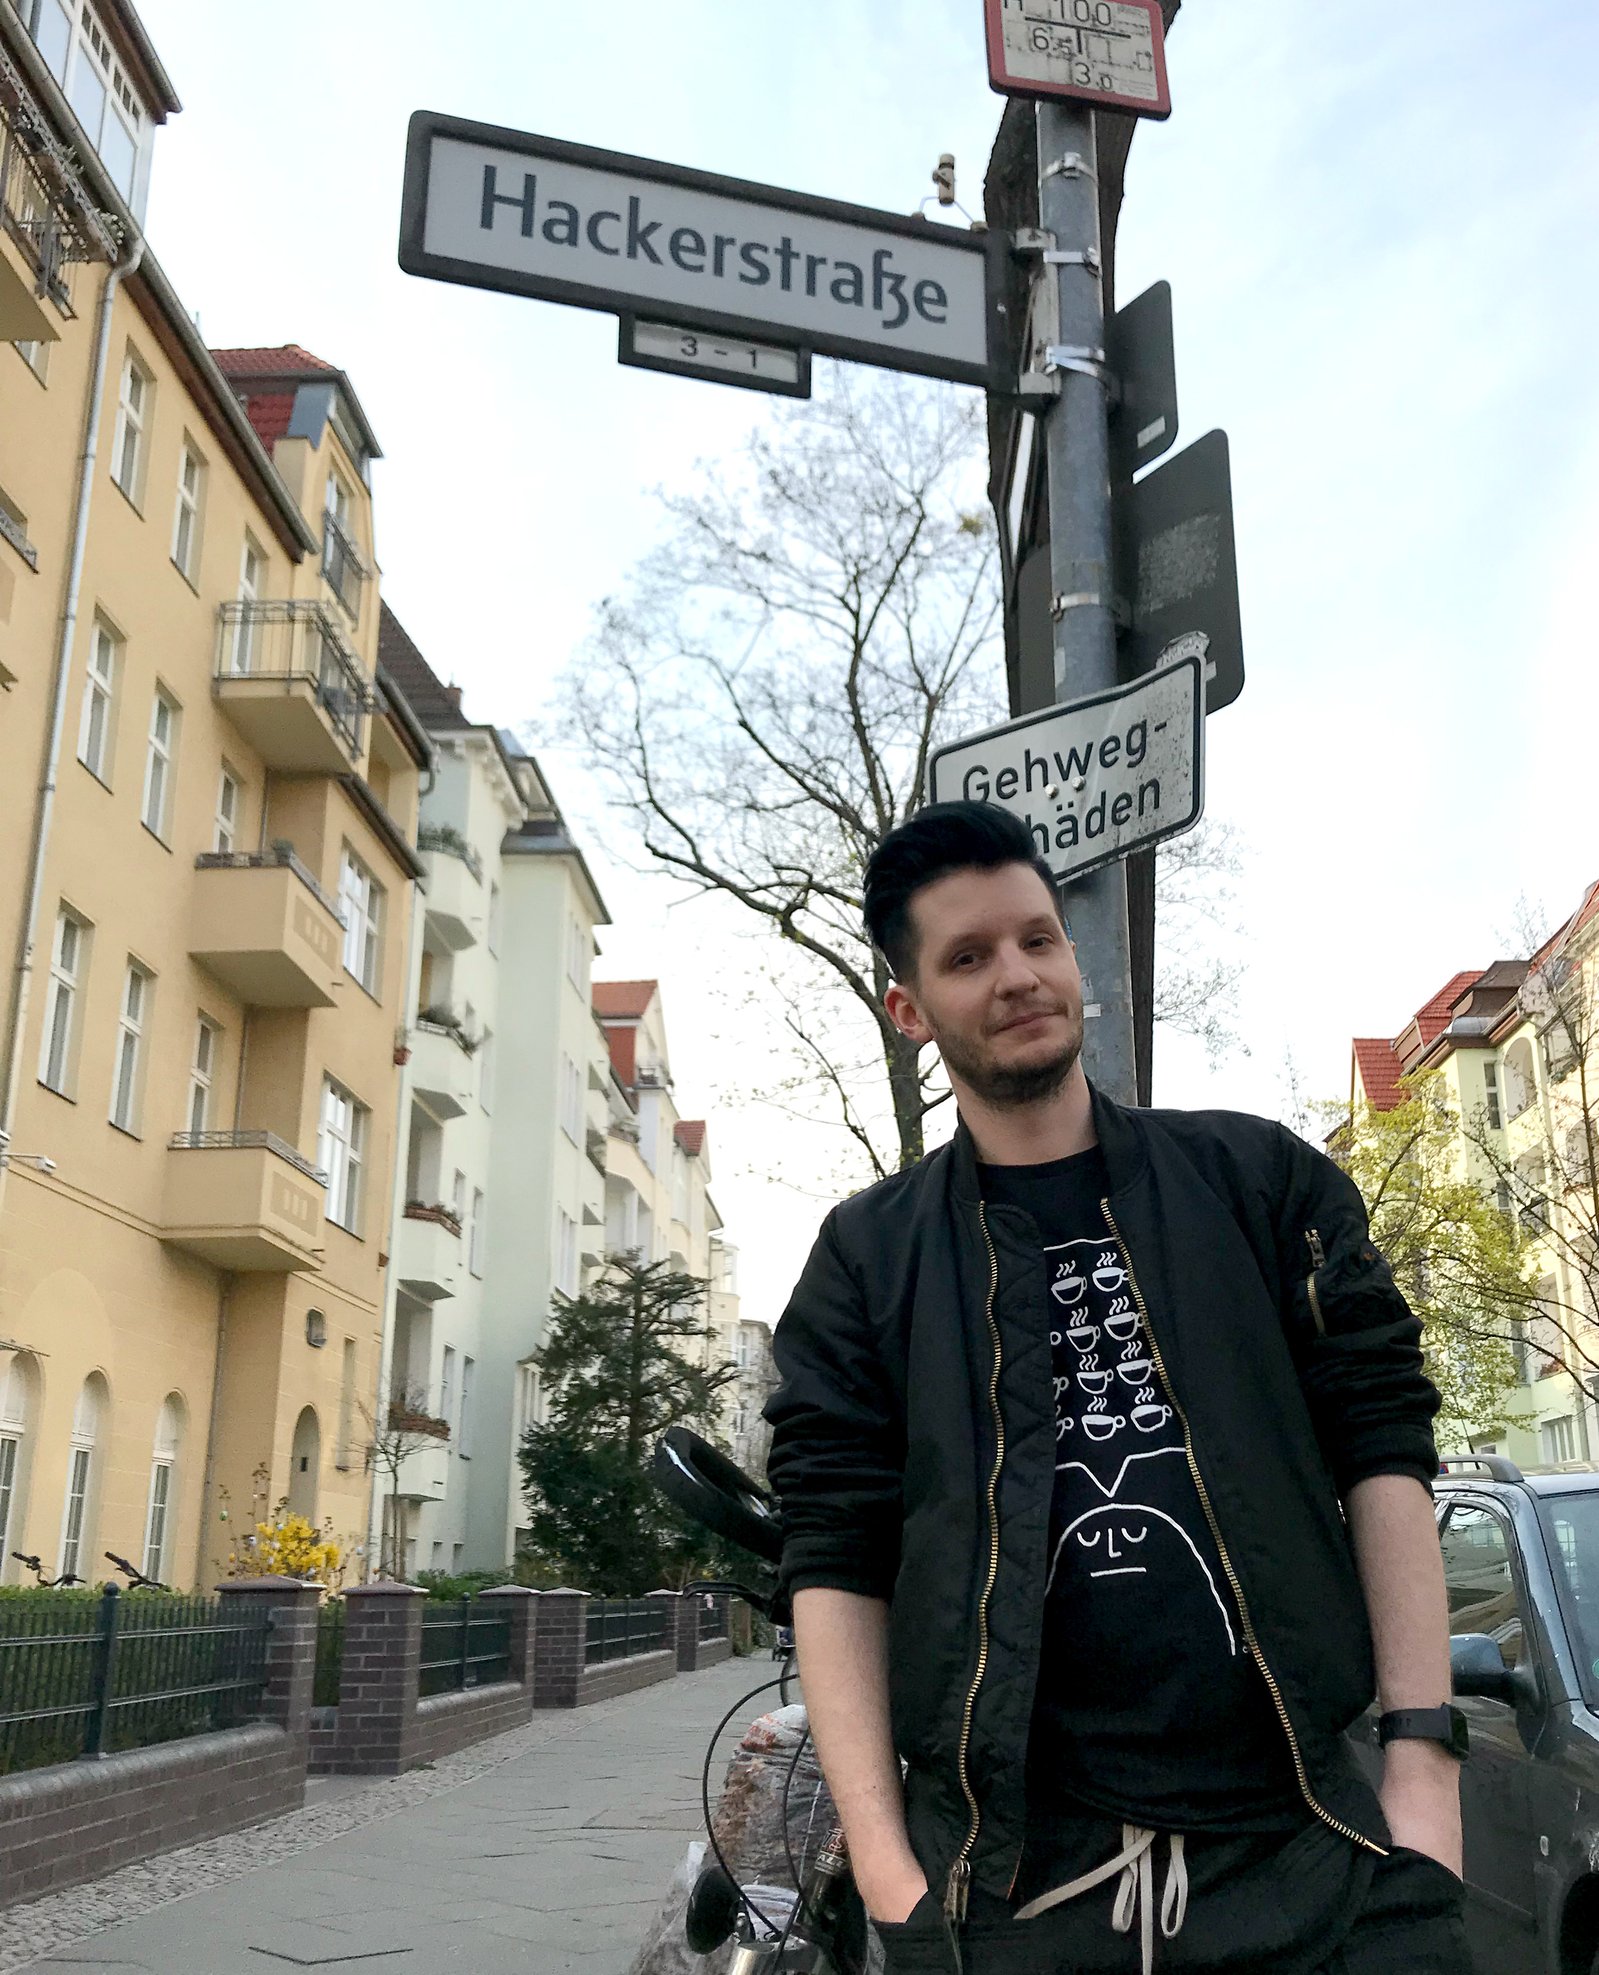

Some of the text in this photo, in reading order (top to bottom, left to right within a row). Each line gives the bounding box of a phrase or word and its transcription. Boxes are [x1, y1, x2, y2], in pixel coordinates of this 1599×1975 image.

[479, 164, 947, 330] Hackerstraße
[681, 335, 698, 357] 3
[747, 349, 757, 369] 1
[963, 718, 1167, 802] Gehweg-
[1025, 777, 1160, 855] häden
